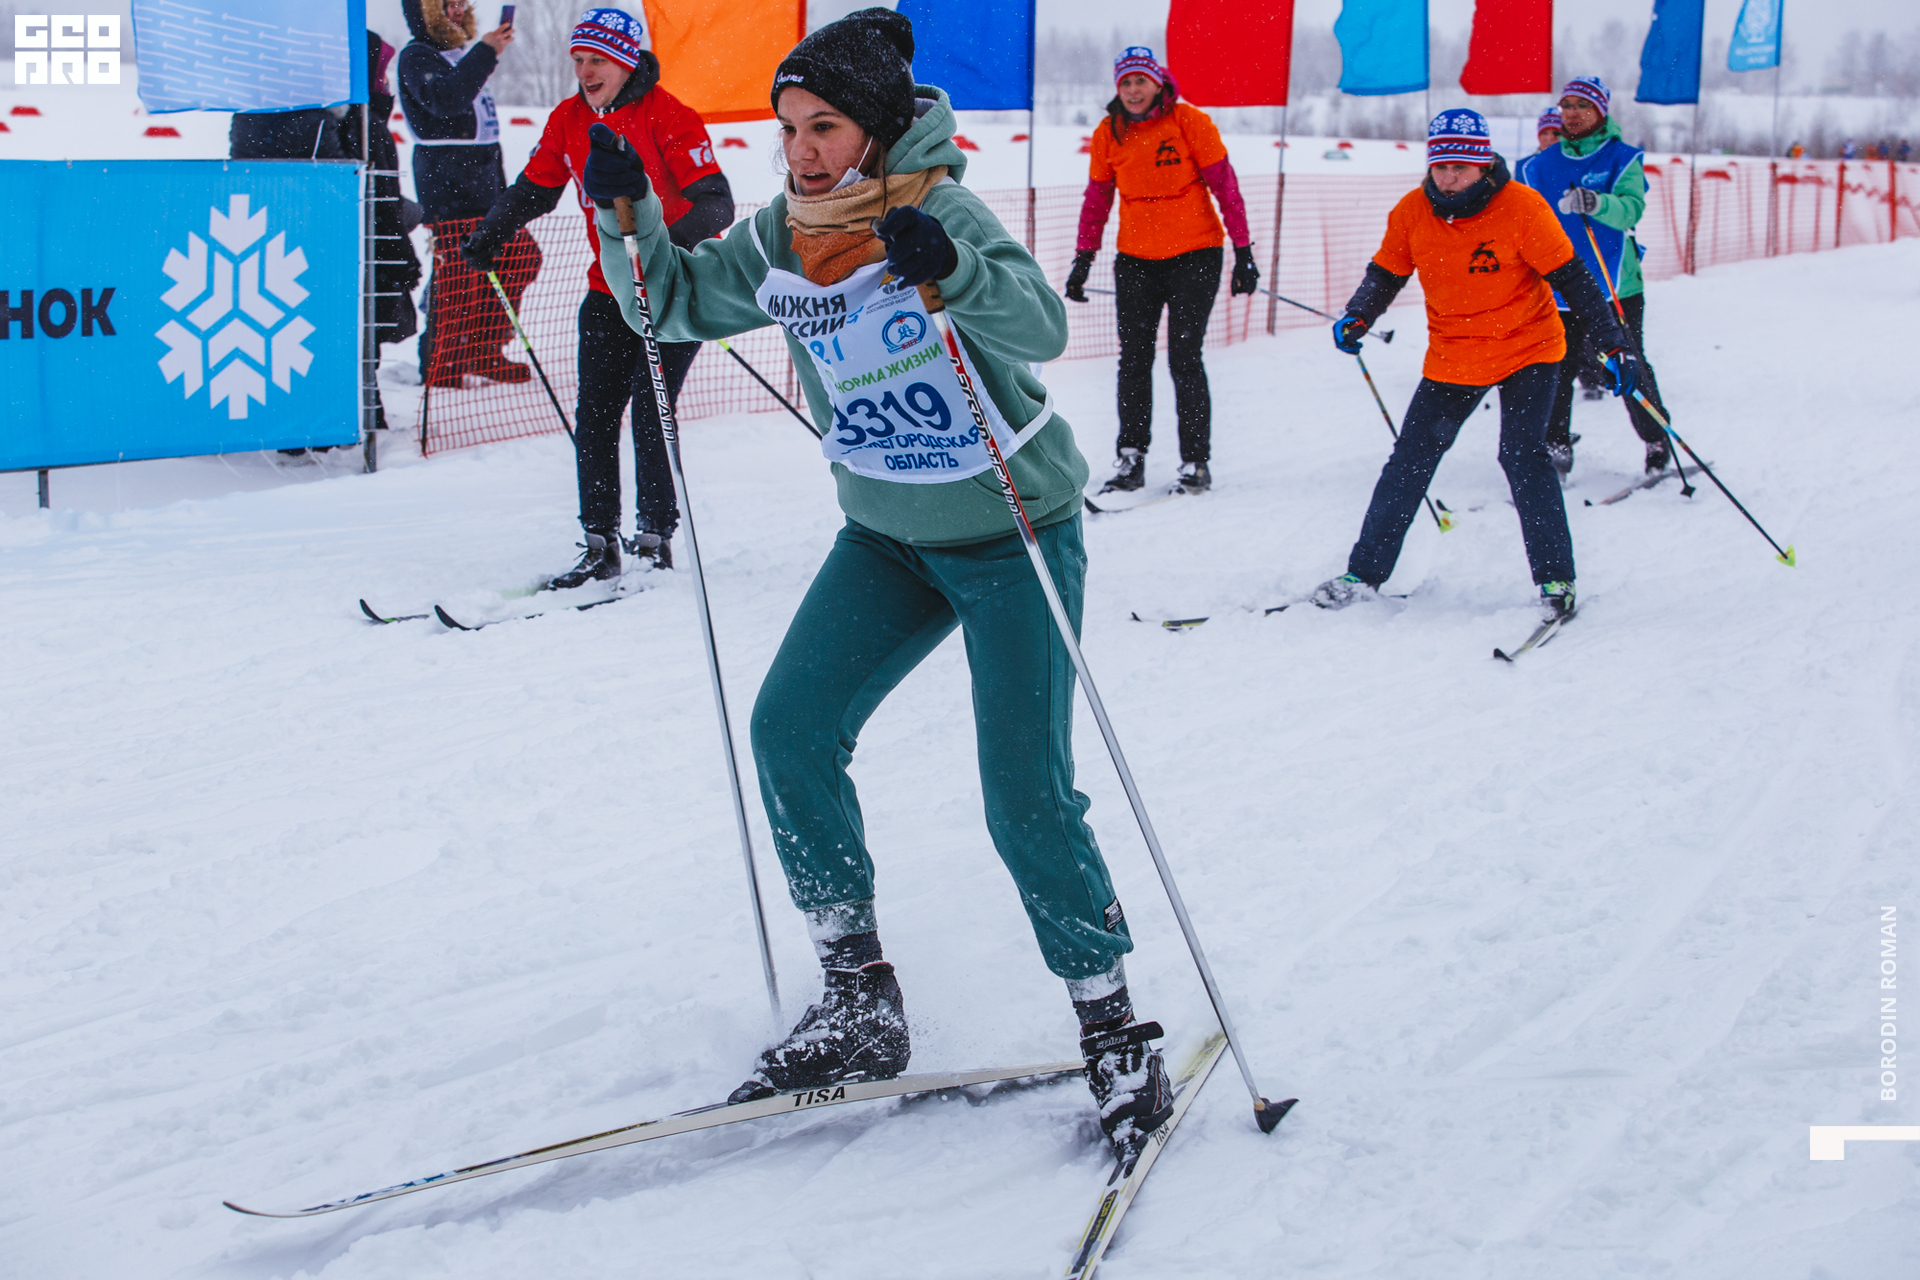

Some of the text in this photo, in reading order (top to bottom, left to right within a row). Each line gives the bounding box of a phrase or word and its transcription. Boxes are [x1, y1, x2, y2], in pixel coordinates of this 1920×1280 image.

[1469, 264, 1499, 273] ГАЗ
[779, 314, 847, 340] ССИИ
[884, 341, 943, 378] ЖИЗНИ
[652, 373, 676, 442] TEAM
[884, 452, 959, 470] ОБЛАСТЬ
[792, 1086, 845, 1107] TISA
[1152, 1123, 1170, 1146] TISA
